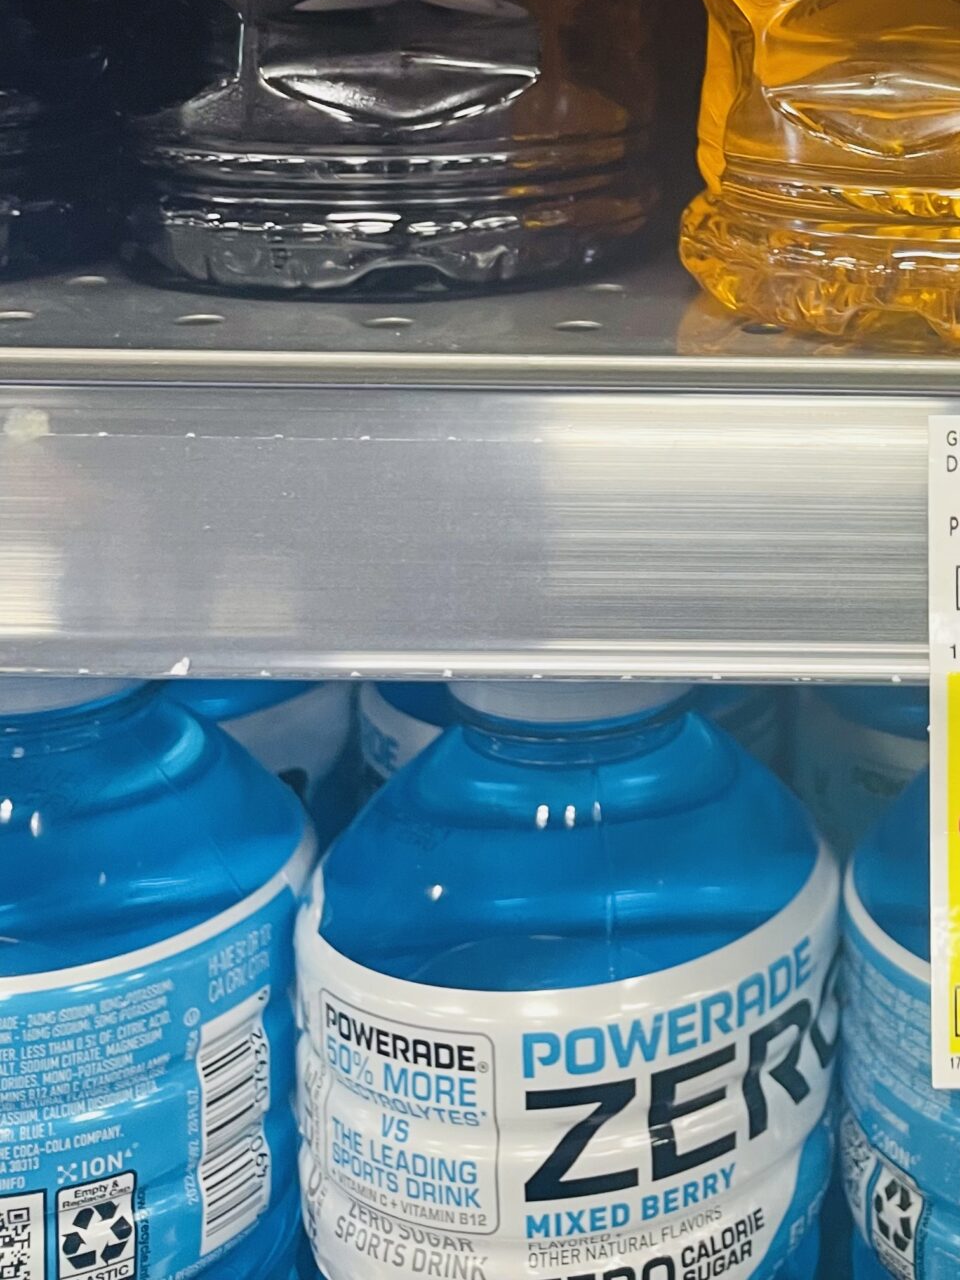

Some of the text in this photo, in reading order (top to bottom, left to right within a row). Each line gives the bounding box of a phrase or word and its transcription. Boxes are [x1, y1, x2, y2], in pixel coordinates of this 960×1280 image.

[521, 935, 812, 1080] POWERADE
[326, 1034, 478, 1108] 50% MORE
[523, 946, 841, 1203] ZERO
[12, 1140, 72, 1160] COCA-COLA
[20, 1122, 46, 1140] BLUE
[331, 1115, 478, 1185] THE LEADING
[380, 1113, 410, 1144] VS
[62, 1192, 107, 1209] Replace
[74, 1183, 109, 1200] Empty
[331, 1141, 482, 1210] SPORTS DRINK
[338, 1171, 488, 1227] VITAMIN VITAMIN B12
[525, 1162, 737, 1240] MIXED BERRY
[334, 1214, 408, 1269] SPORTS
[411, 1247, 489, 1280] DRINK
[348, 1196, 476, 1254] ZERO SUGAR
[527, 1247, 582, 1270] OTHER
[584, 1233, 659, 1262] NATURAL
[660, 1207, 724, 1243] FLAVORS
[680, 1206, 767, 1270] CALORIE
[682, 1238, 754, 1280] SUGAR
